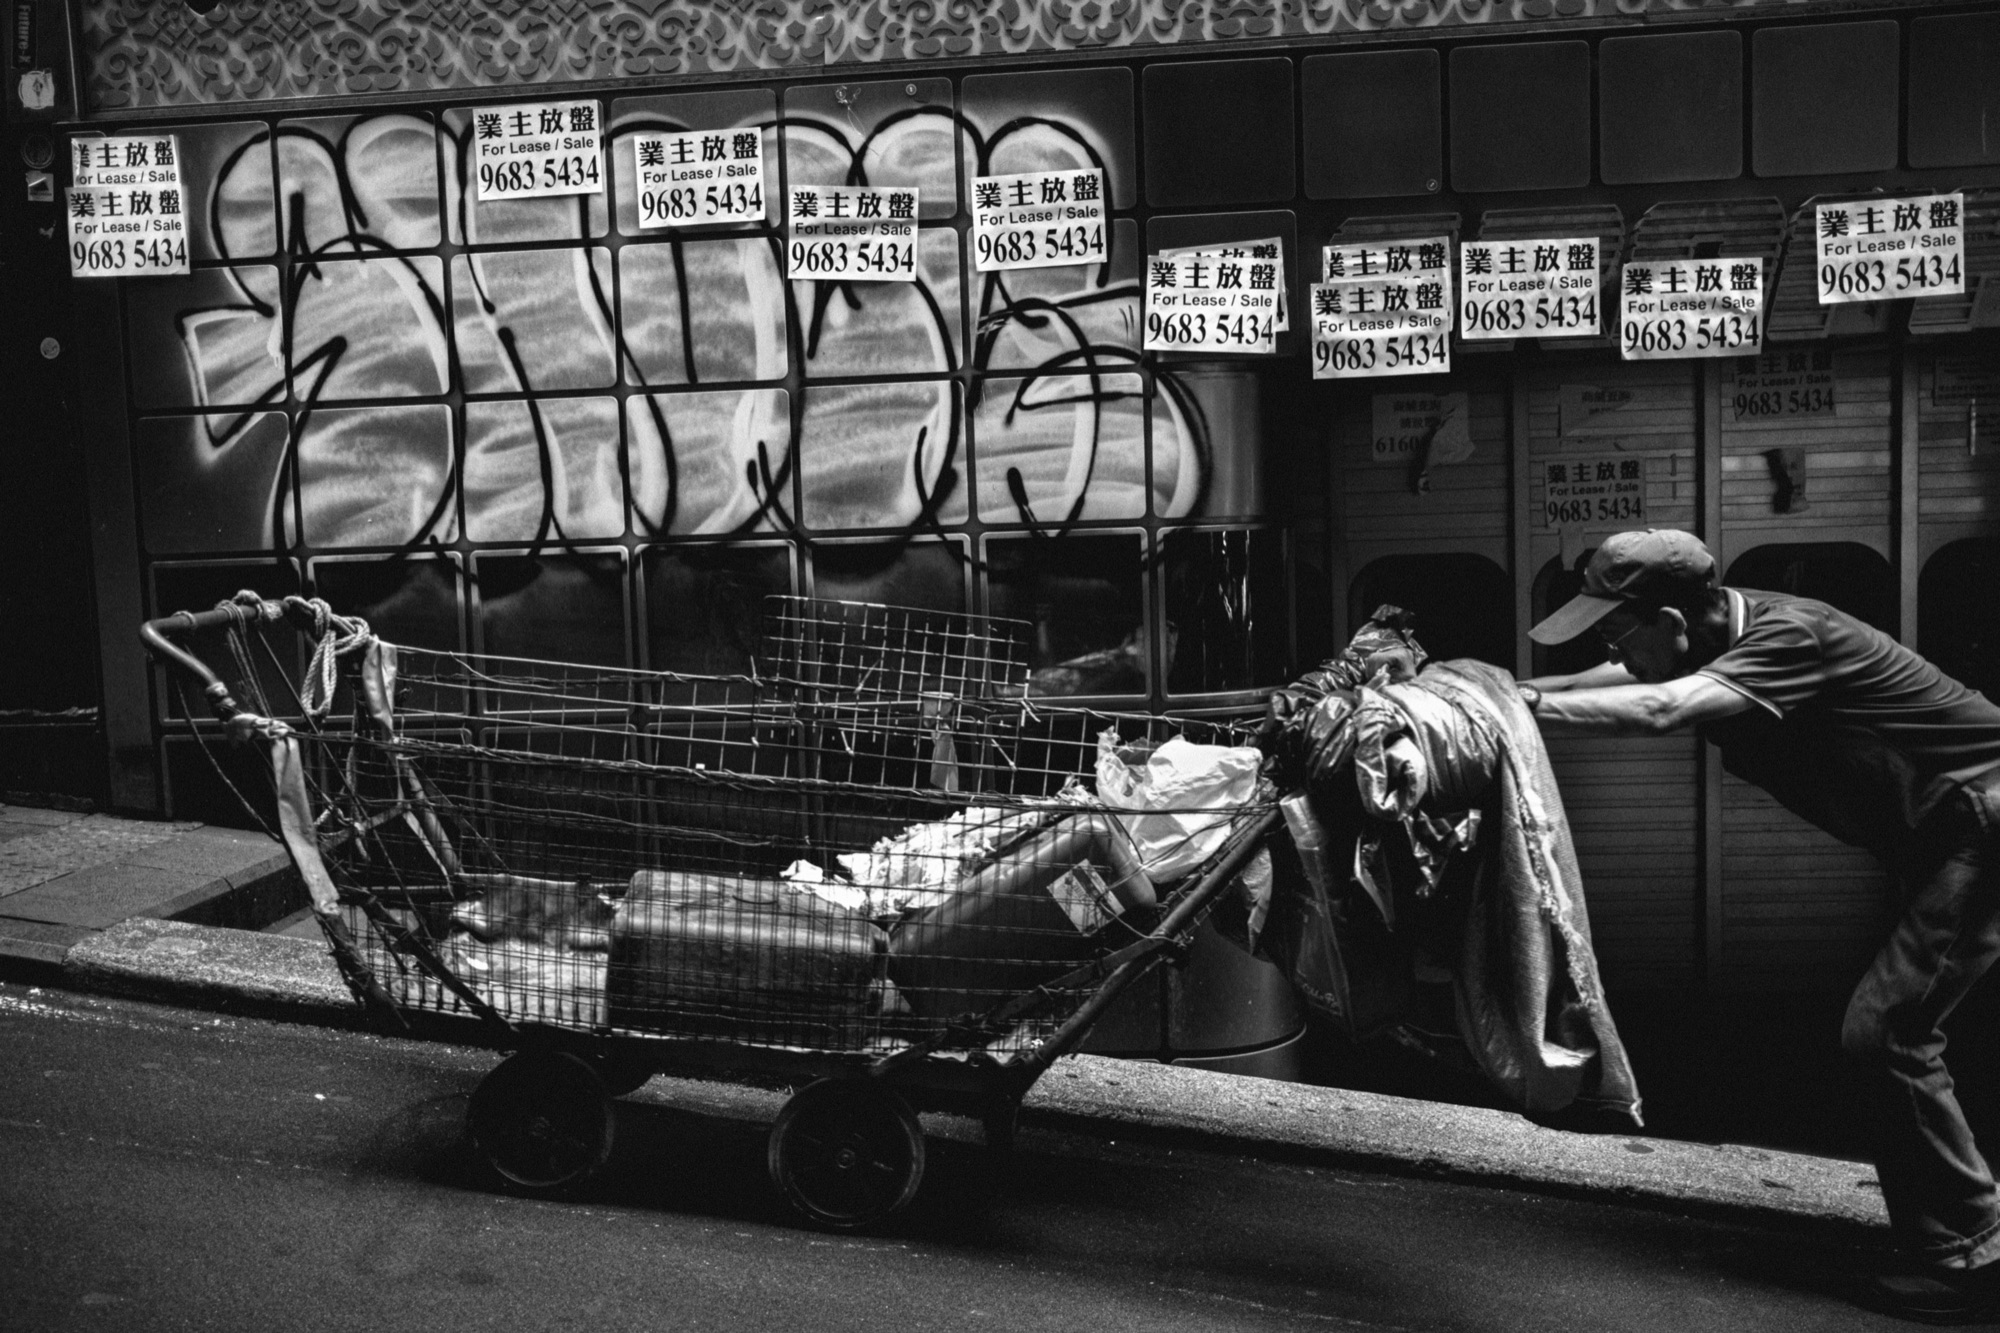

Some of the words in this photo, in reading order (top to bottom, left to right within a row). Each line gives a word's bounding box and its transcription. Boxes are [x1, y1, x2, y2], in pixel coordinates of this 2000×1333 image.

[478, 105, 597, 140] 業主放盤
[481, 143, 506, 157] For
[509, 142, 551, 154] Lease
[554, 138, 559, 150] /
[563, 136, 594, 150] Sale
[639, 132, 759, 168] 業主放盤
[79, 175, 93, 185] or
[97, 173, 136, 185] Lease
[140, 172, 144, 183] /
[148, 170, 176, 183] Sale
[480, 159, 536, 192] 9683
[543, 155, 600, 189] 5434
[643, 171, 668, 184] For
[671, 169, 714, 182] Lease
[717, 165, 722, 178] /
[726, 163, 757, 178] Sale
[70, 189, 181, 218] 業主放盤
[642, 187, 697, 222] 9683
[705, 182, 763, 216] 5434
[793, 191, 915, 220] 業主放盤
[975, 173, 1100, 209] 業主放盤
[74, 222, 98, 235] For
[102, 222, 141, 233] Lease
[145, 220, 149, 231] /
[153, 219, 182, 232] Sale
[795, 222, 821, 235] For
[824, 222, 868, 236] Lease
[871, 223, 877, 236] /
[880, 223, 912, 236] Sale
[979, 213, 1005, 226] For
[1009, 211, 1053, 224] Lease
[1057, 207, 1062, 220] /
[1066, 205, 1099, 220] Sale
[1821, 199, 1959, 239] 業主放盤
[73, 239, 126, 270] 9683
[133, 237, 187, 268] 5434
[791, 242, 848, 273] 9683
[856, 242, 914, 273] 5434
[978, 230, 1037, 265] 9683
[1045, 224, 1104, 259] 5434
[1465, 243, 1595, 275] 業主放盤
[1824, 243, 1852, 257] For
[1857, 239, 1906, 254] Lease
[1911, 235, 1916, 249] /
[1920, 233, 1956, 248] Sale
[1151, 261, 1276, 290] 業主放盤
[1468, 280, 1495, 293] For
[1499, 279, 1546, 292] Lease
[1549, 277, 1555, 290] /
[1559, 275, 1593, 289] Sale
[1625, 263, 1758, 296] 業主放盤
[1821, 259, 1886, 295] 9683
[1896, 253, 1961, 291] 5434
[1152, 292, 1178, 306] For
[1182, 293, 1227, 306] Lease
[1231, 294, 1236, 306] /
[1240, 294, 1273, 308] Sale
[1315, 282, 1444, 316] 業主放盤
[1464, 298, 1526, 332] 9683
[1535, 294, 1597, 329] 5434
[1628, 300, 1655, 314] For
[1660, 299, 1707, 313] Lease
[1711, 297, 1717, 310] /
[1721, 295, 1755, 310] Sale
[1148, 312, 1207, 344] 9683
[1215, 314, 1274, 345] 5434
[1318, 320, 1344, 334] For
[1349, 319, 1394, 332] Lease
[1399, 315, 1405, 328] /
[1408, 314, 1442, 328] Sale
[1624, 318, 1687, 352] 9683
[1696, 315, 1760, 350] 5434
[1316, 337, 1377, 372] 9683
[1385, 333, 1447, 368] 5434
[1737, 350, 1832, 376] 業主放盤
[1738, 378, 1759, 389] For
[1761, 377, 1796, 388] Lease
[1798, 375, 1804, 385] /
[1806, 373, 1831, 385] Sale
[1736, 390, 1782, 417] 9683
[1788, 387, 1835, 414] 5434
[1548, 460, 1640, 484] 業主放盤
[1549, 486, 1569, 497] For
[1571, 485, 1606, 496] Lease
[1607, 483, 1613, 493] /
[1614, 482, 1639, 493] Sale
[1547, 498, 1593, 524] 9683
[1597, 496, 1643, 522] 5434
